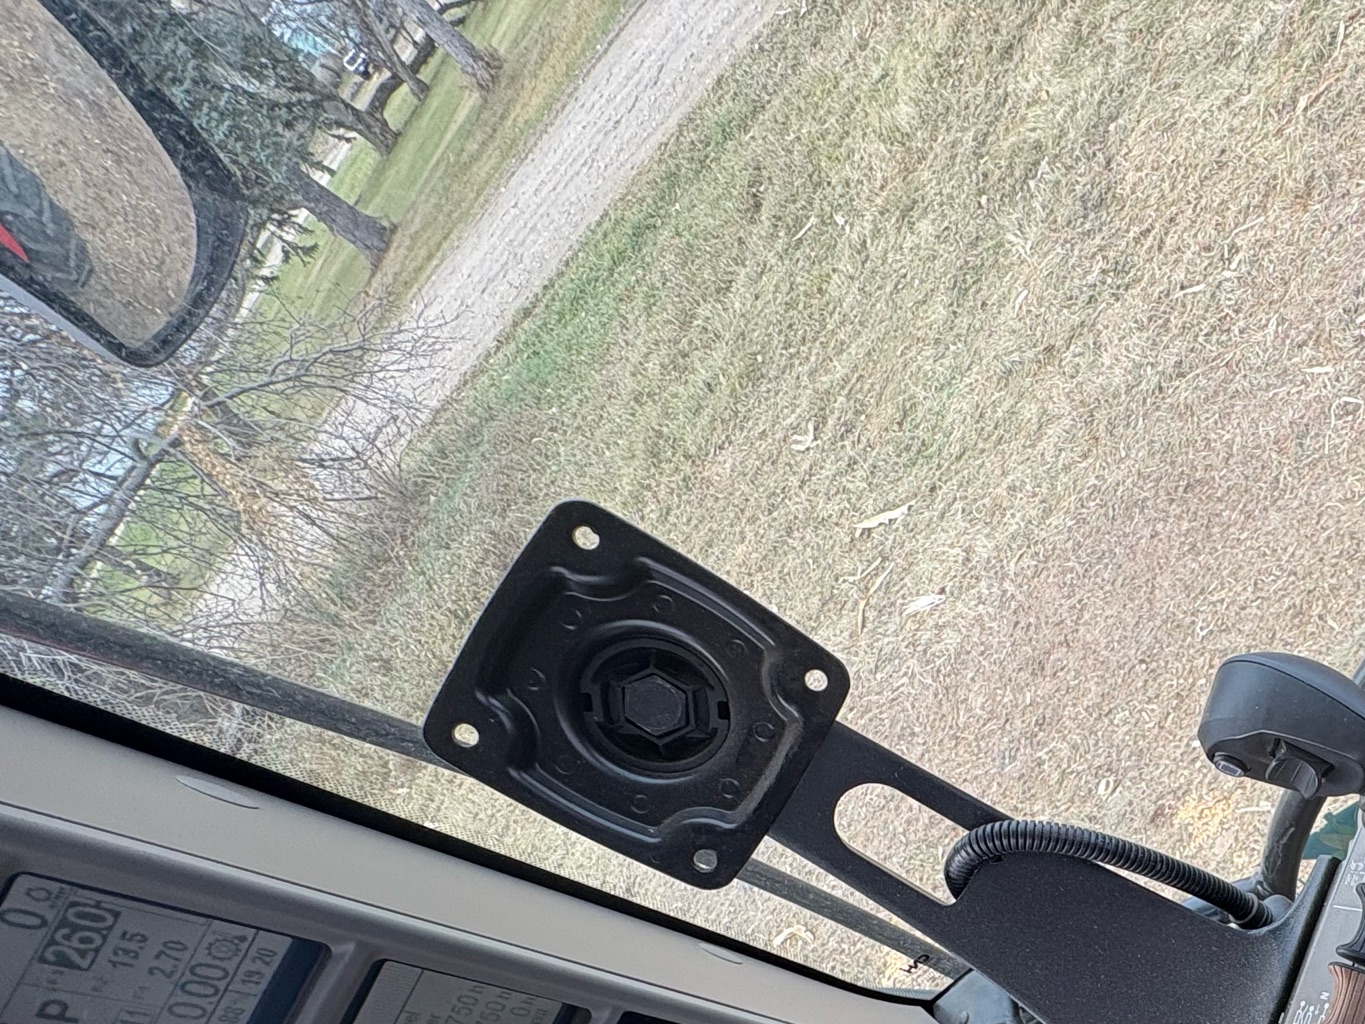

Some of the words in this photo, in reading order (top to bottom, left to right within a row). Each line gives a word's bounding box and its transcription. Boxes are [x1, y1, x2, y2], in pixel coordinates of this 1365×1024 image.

[42, 902, 117, 969] 26.0
[149, 939, 189, 979] 2.70
[35, 999, 80, 1023] P
[167, 961, 230, 1020] 0.00
